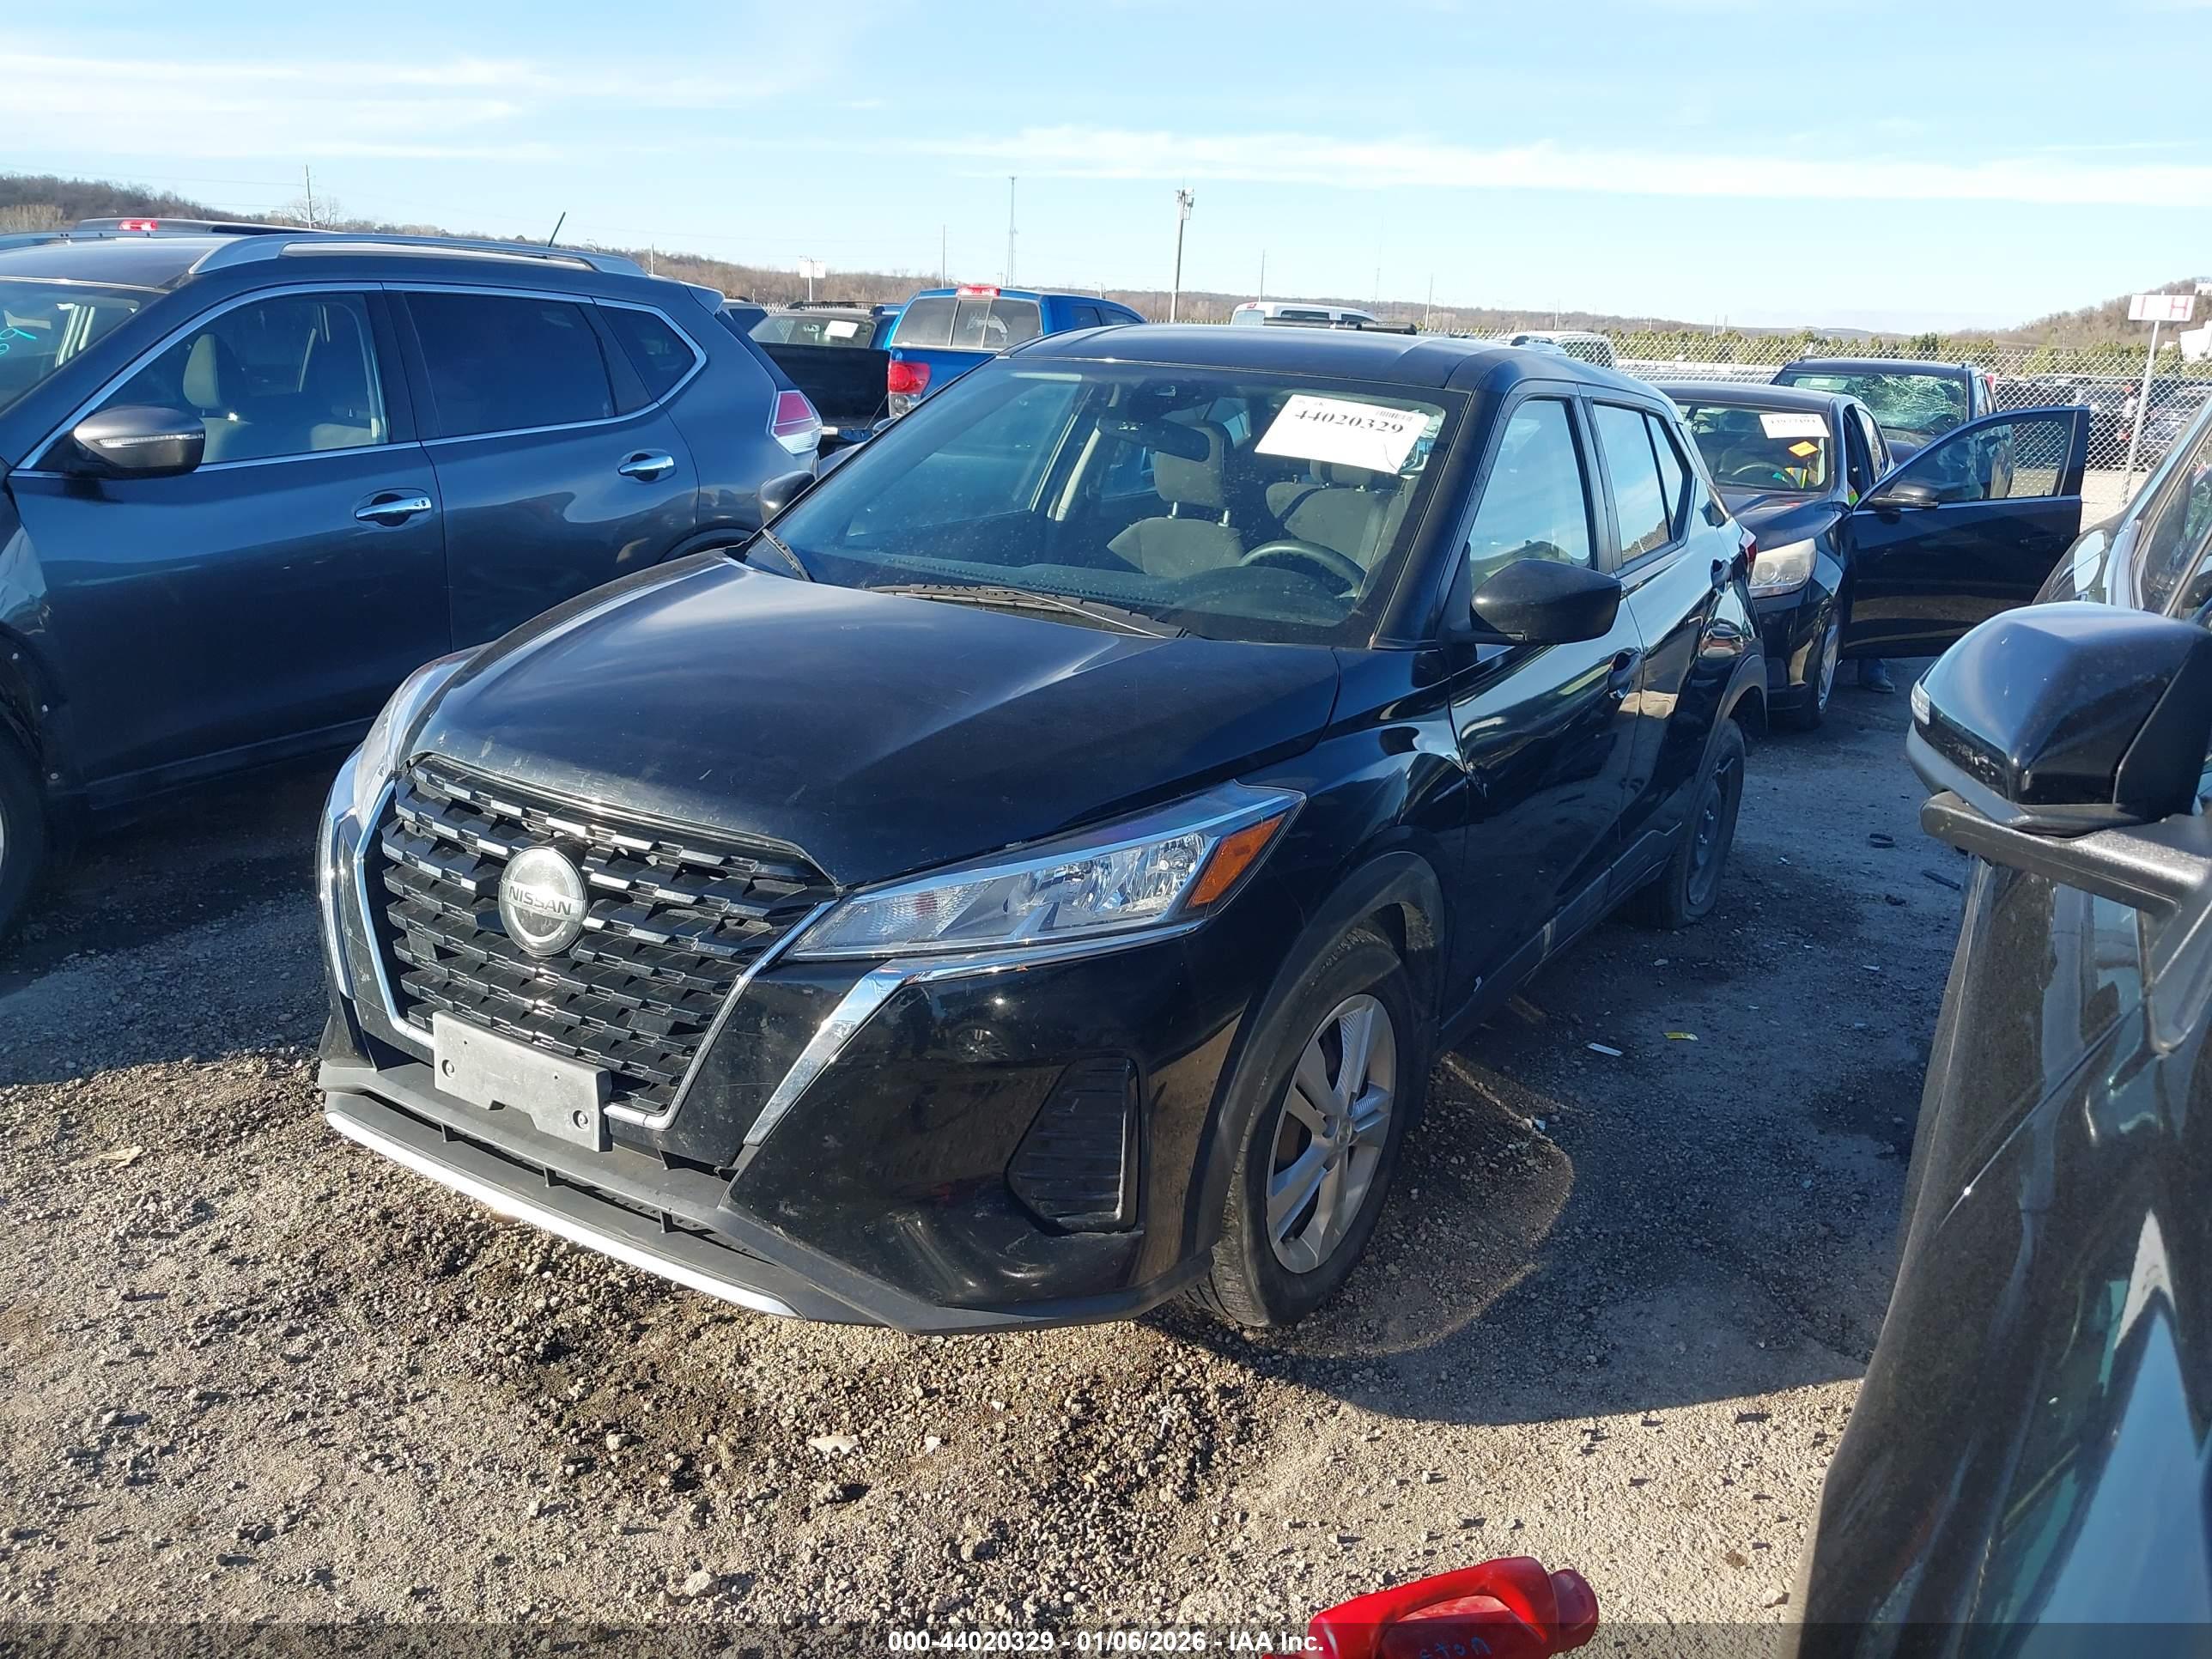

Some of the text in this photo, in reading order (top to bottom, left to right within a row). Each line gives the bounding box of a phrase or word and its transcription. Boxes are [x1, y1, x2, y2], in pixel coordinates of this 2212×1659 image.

[2168, 297, 2190, 319] H
[1295, 409, 1404, 434] 44020329
[508, 885, 572, 916] NISSAN
